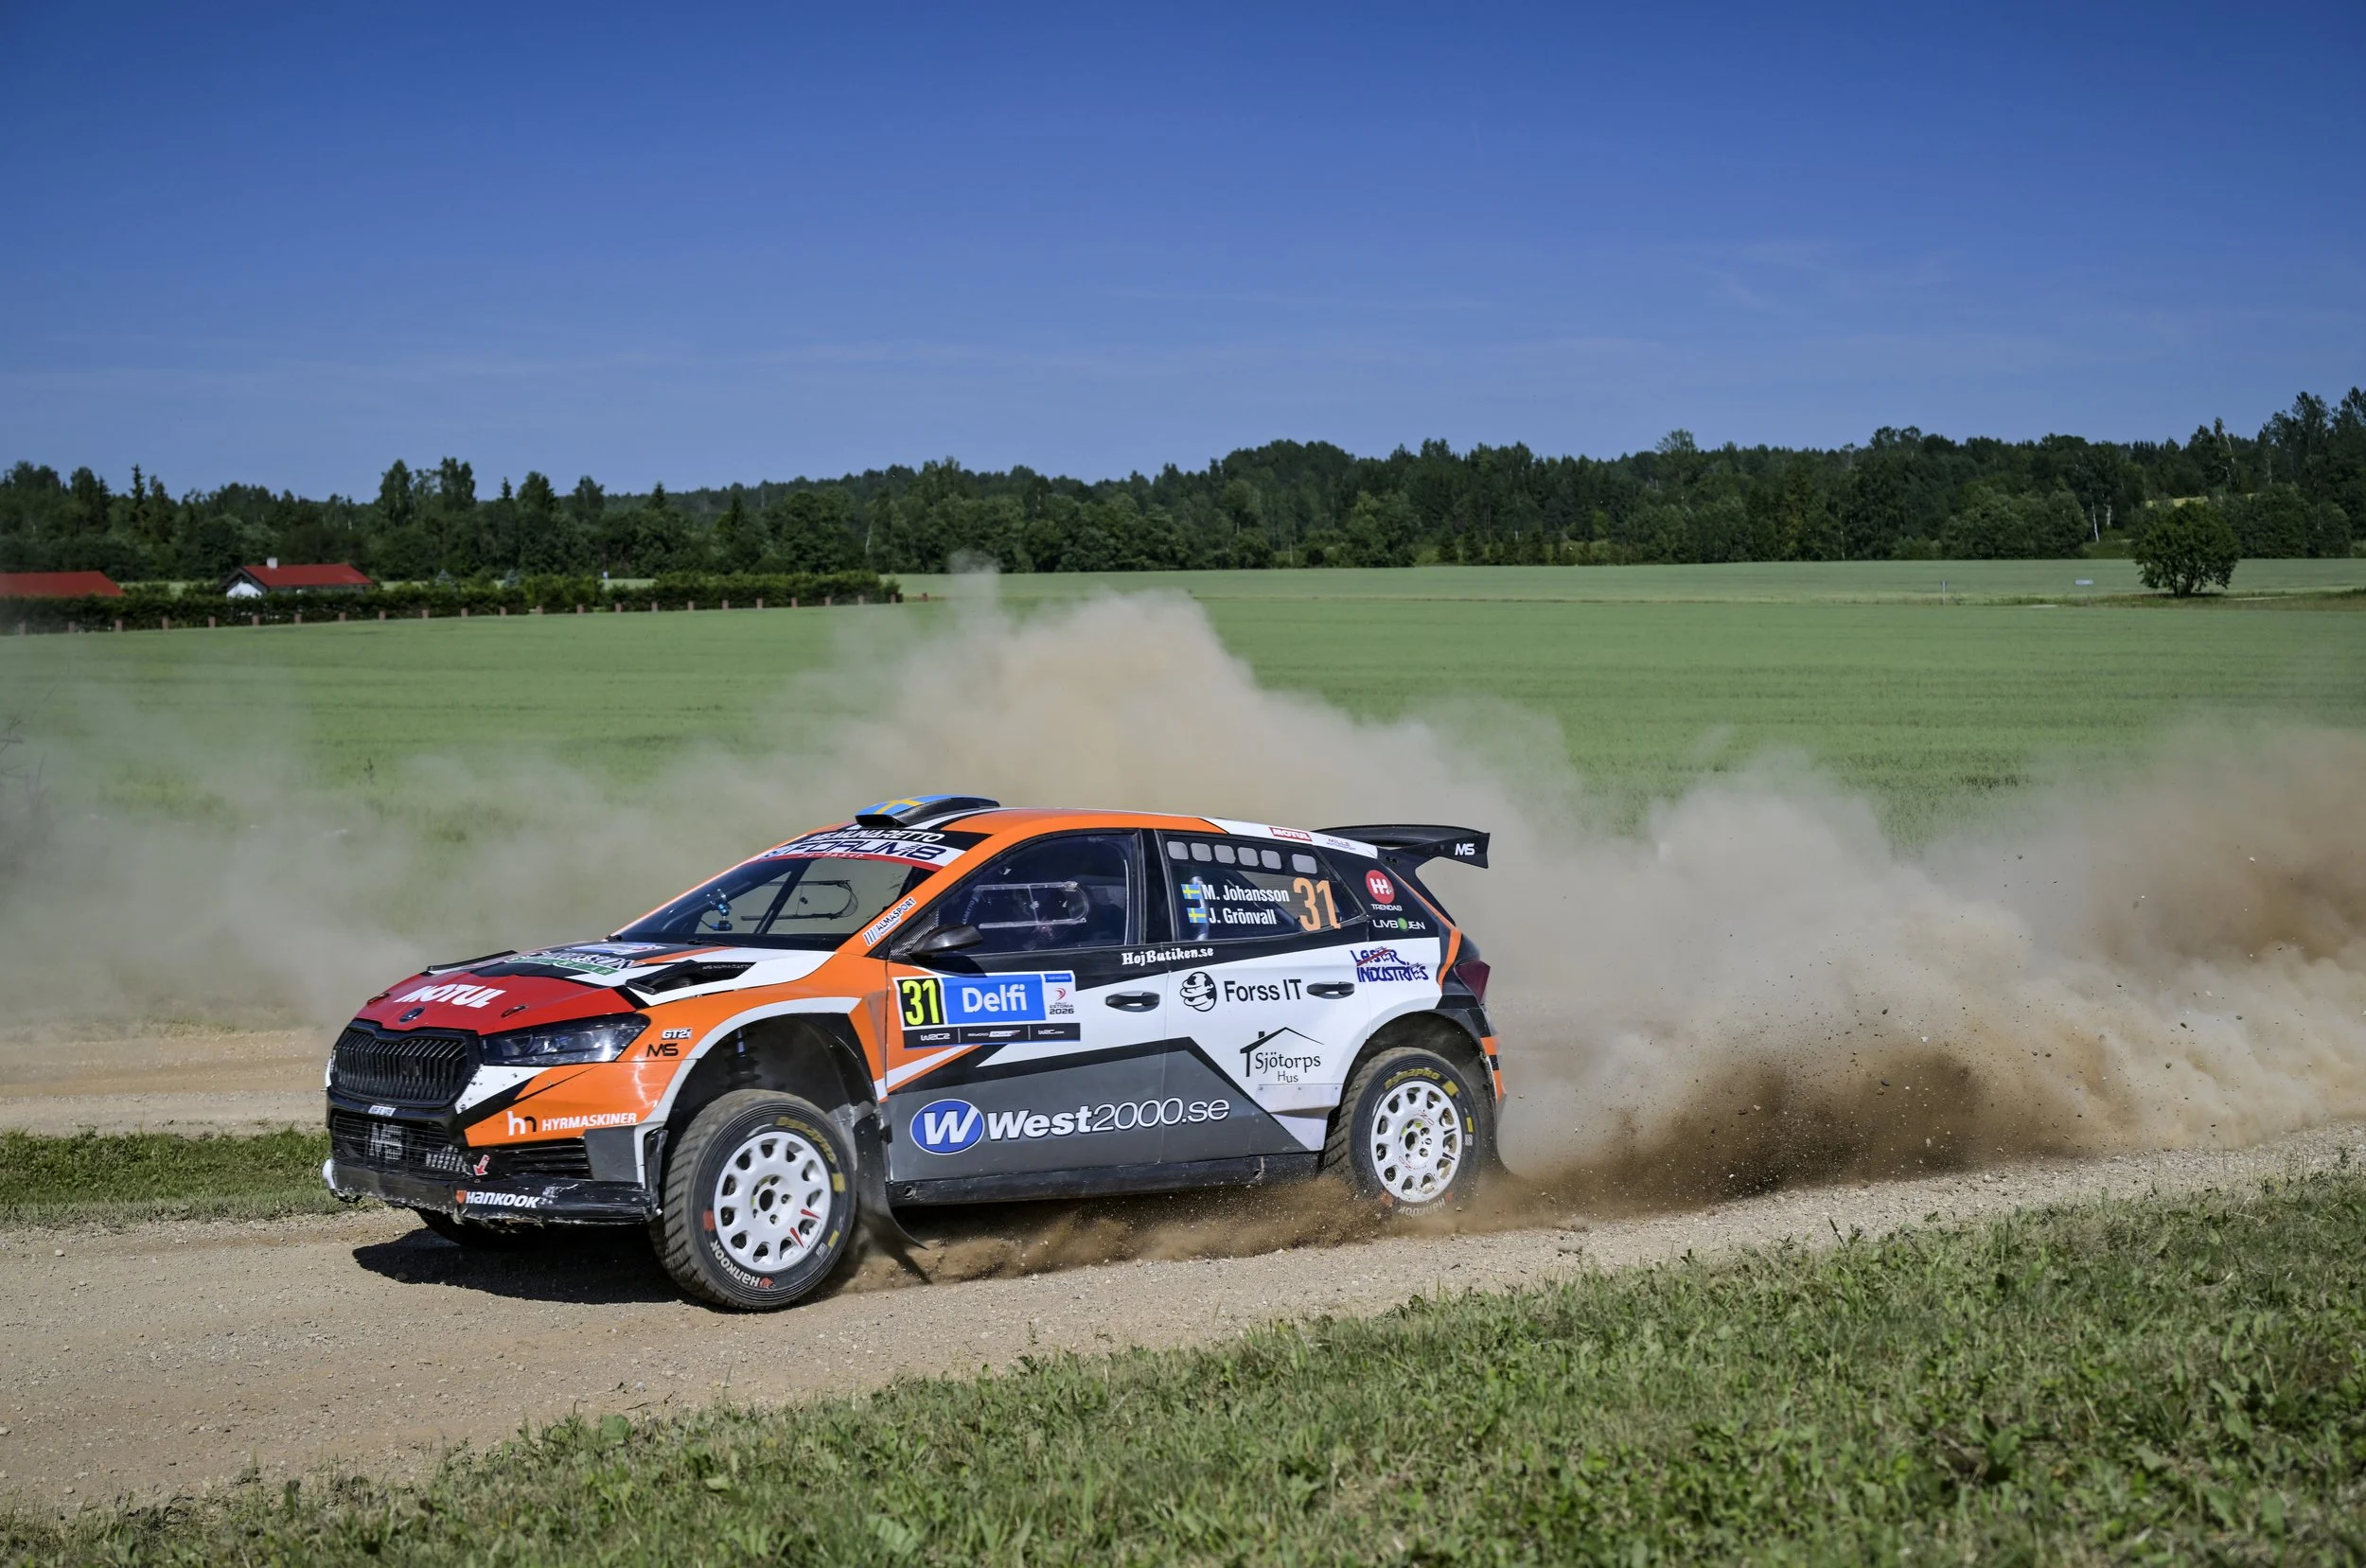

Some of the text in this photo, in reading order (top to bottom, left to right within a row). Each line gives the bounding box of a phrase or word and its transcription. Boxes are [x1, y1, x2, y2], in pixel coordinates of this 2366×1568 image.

[834, 829, 945, 843] MUNARETTO
[1272, 828, 1310, 839] MOTUL
[784, 839, 946, 861] FORUM8
[1201, 884, 1290, 902] M. Johansson
[876, 897, 916, 931] ALMASPORT
[1293, 877, 1342, 932] 31
[1209, 907, 1278, 925] J. Grönvall
[1356, 962, 1429, 982] INDUSTRIES
[394, 984, 508, 1008] MOTUL
[1224, 978, 1302, 1002] Forss IT
[902, 979, 1028, 1026] 31 Delfi
[662, 1028, 692, 1040] GT2i
[646, 1043, 679, 1057] MS
[1255, 1052, 1321, 1073] Sjötorps
[1277, 1071, 1298, 1083] Hus
[541, 1112, 637, 1131] HYRMASKINER
[987, 1098, 1230, 1140] West2000.se
